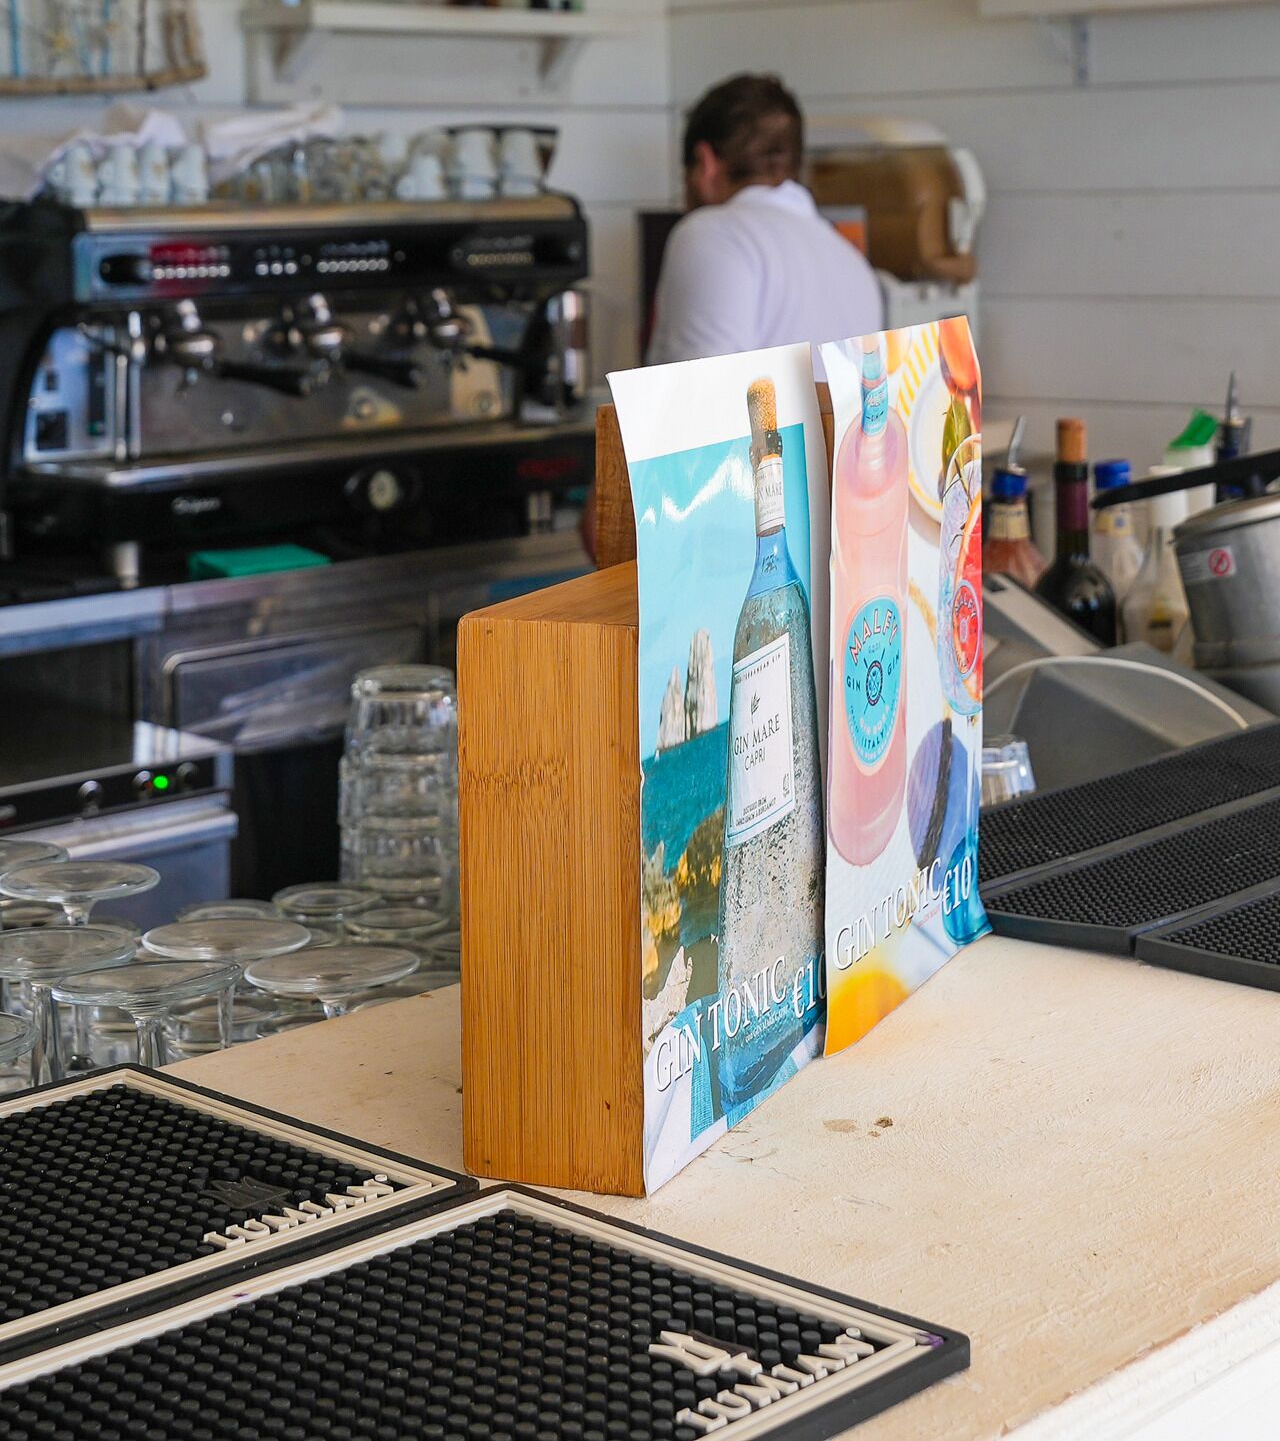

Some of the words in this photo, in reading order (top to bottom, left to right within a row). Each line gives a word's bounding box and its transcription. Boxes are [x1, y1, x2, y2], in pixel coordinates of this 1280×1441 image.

[849, 608, 898, 664] MALFY
[846, 675, 861, 691] GIN
[887, 650, 900, 676] GIN
[734, 733, 749, 756] GIN
[752, 713, 781, 746] MARE
[744, 747, 766, 771] CAPRI
[832, 906, 877, 970] GIN
[882, 857, 942, 939] TONIC
[942, 855, 972, 917] €10
[655, 1013, 703, 1092] GIN
[707, 955, 787, 1052] TONIC
